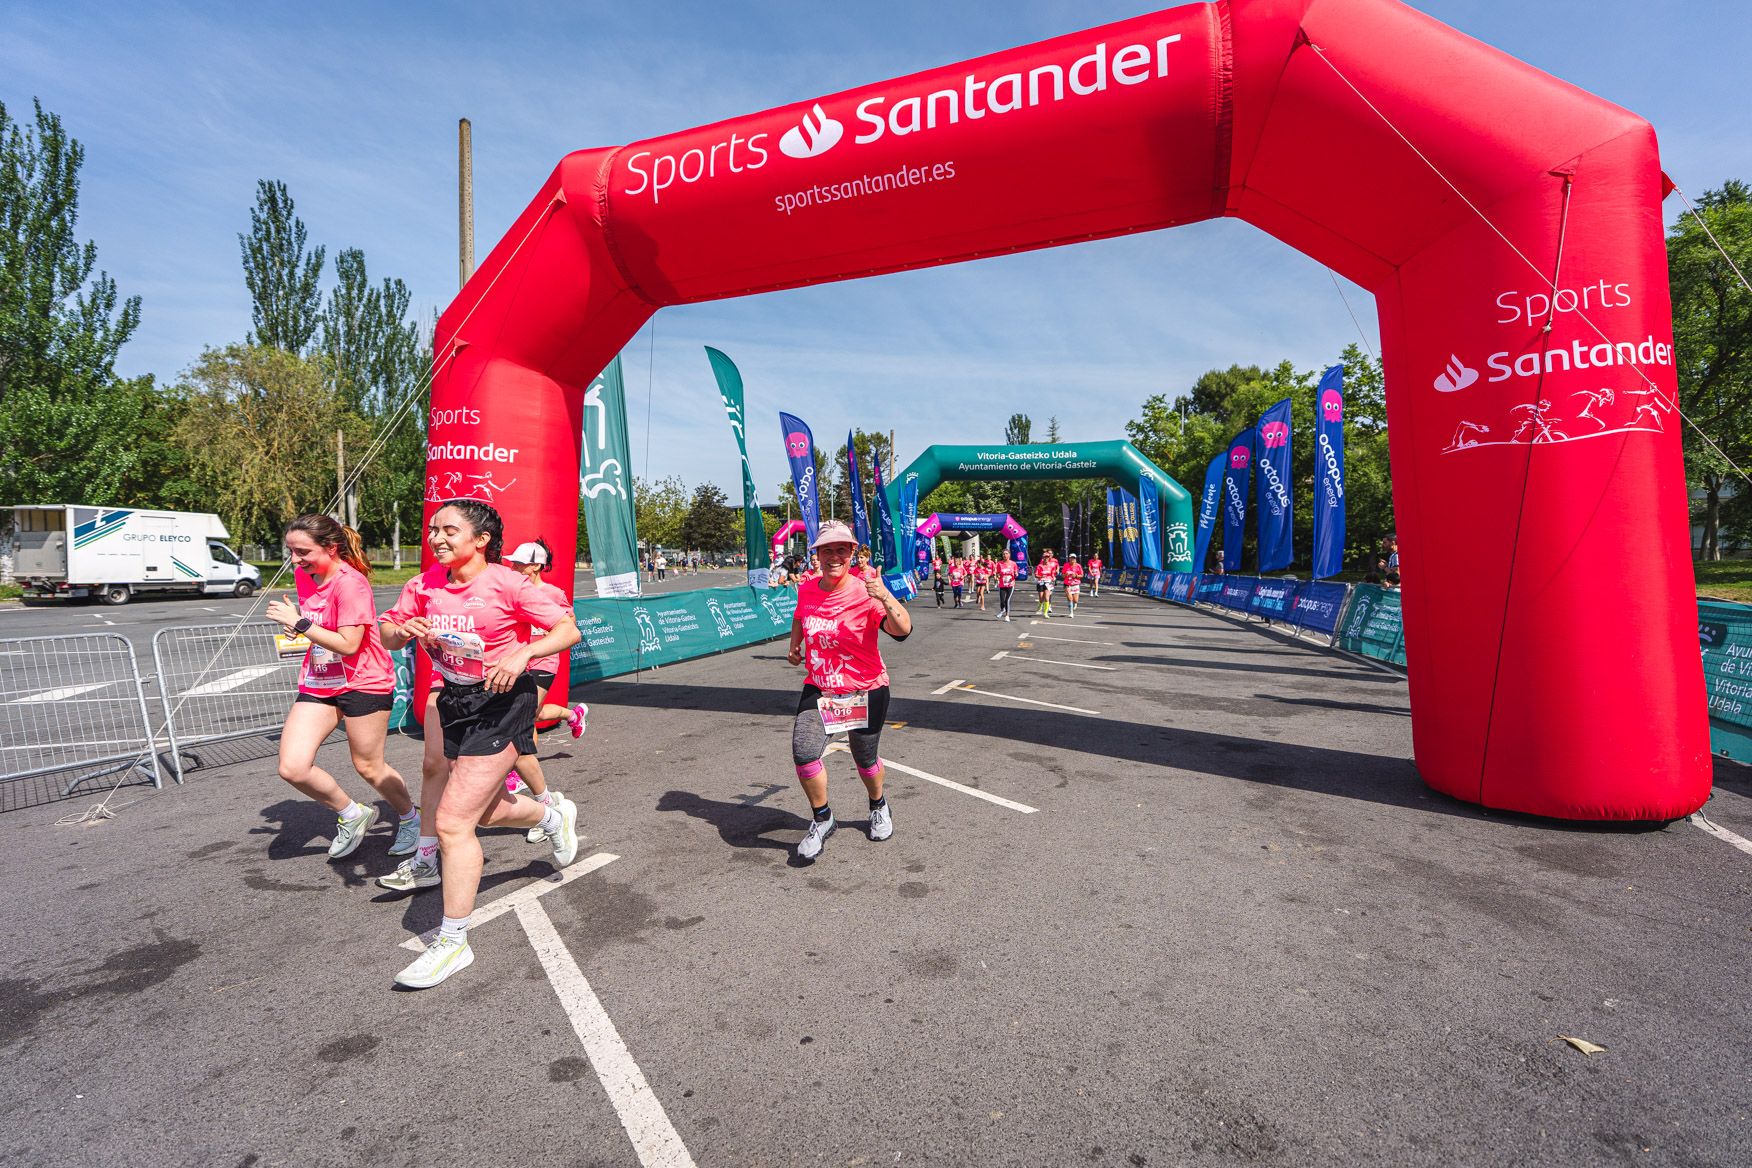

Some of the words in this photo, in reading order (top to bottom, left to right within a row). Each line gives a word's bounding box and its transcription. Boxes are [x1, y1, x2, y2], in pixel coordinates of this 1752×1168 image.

[624, 132, 768, 204] Sports
[854, 34, 1181, 145] Santander
[774, 160, 956, 215] sportssantander.es
[1496, 279, 1631, 327] Sports
[1487, 335, 1673, 383] Santander
[431, 406, 480, 431] Sports
[426, 441, 519, 463] Santander
[958, 462, 1018, 472] Ayuntamiento
[1020, 461, 1031, 470] de
[1033, 460, 1097, 470] Vitoria-Gasteiz
[977, 451, 1050, 460] Vitoria-Gasteizko
[1052, 450, 1077, 459] Udala
[1319, 433, 1343, 498] octopus
[1226, 476, 1245, 521] octopus
[1260, 458, 1291, 508] octopus
[1200, 484, 1216, 529] Marlene
[123, 533, 156, 542] GRUPO
[159, 535, 191, 543] ELEYCO
[1721, 659, 1736, 673] de
[833, 708, 852, 716] 016
[1709, 695, 1742, 713] Udala
